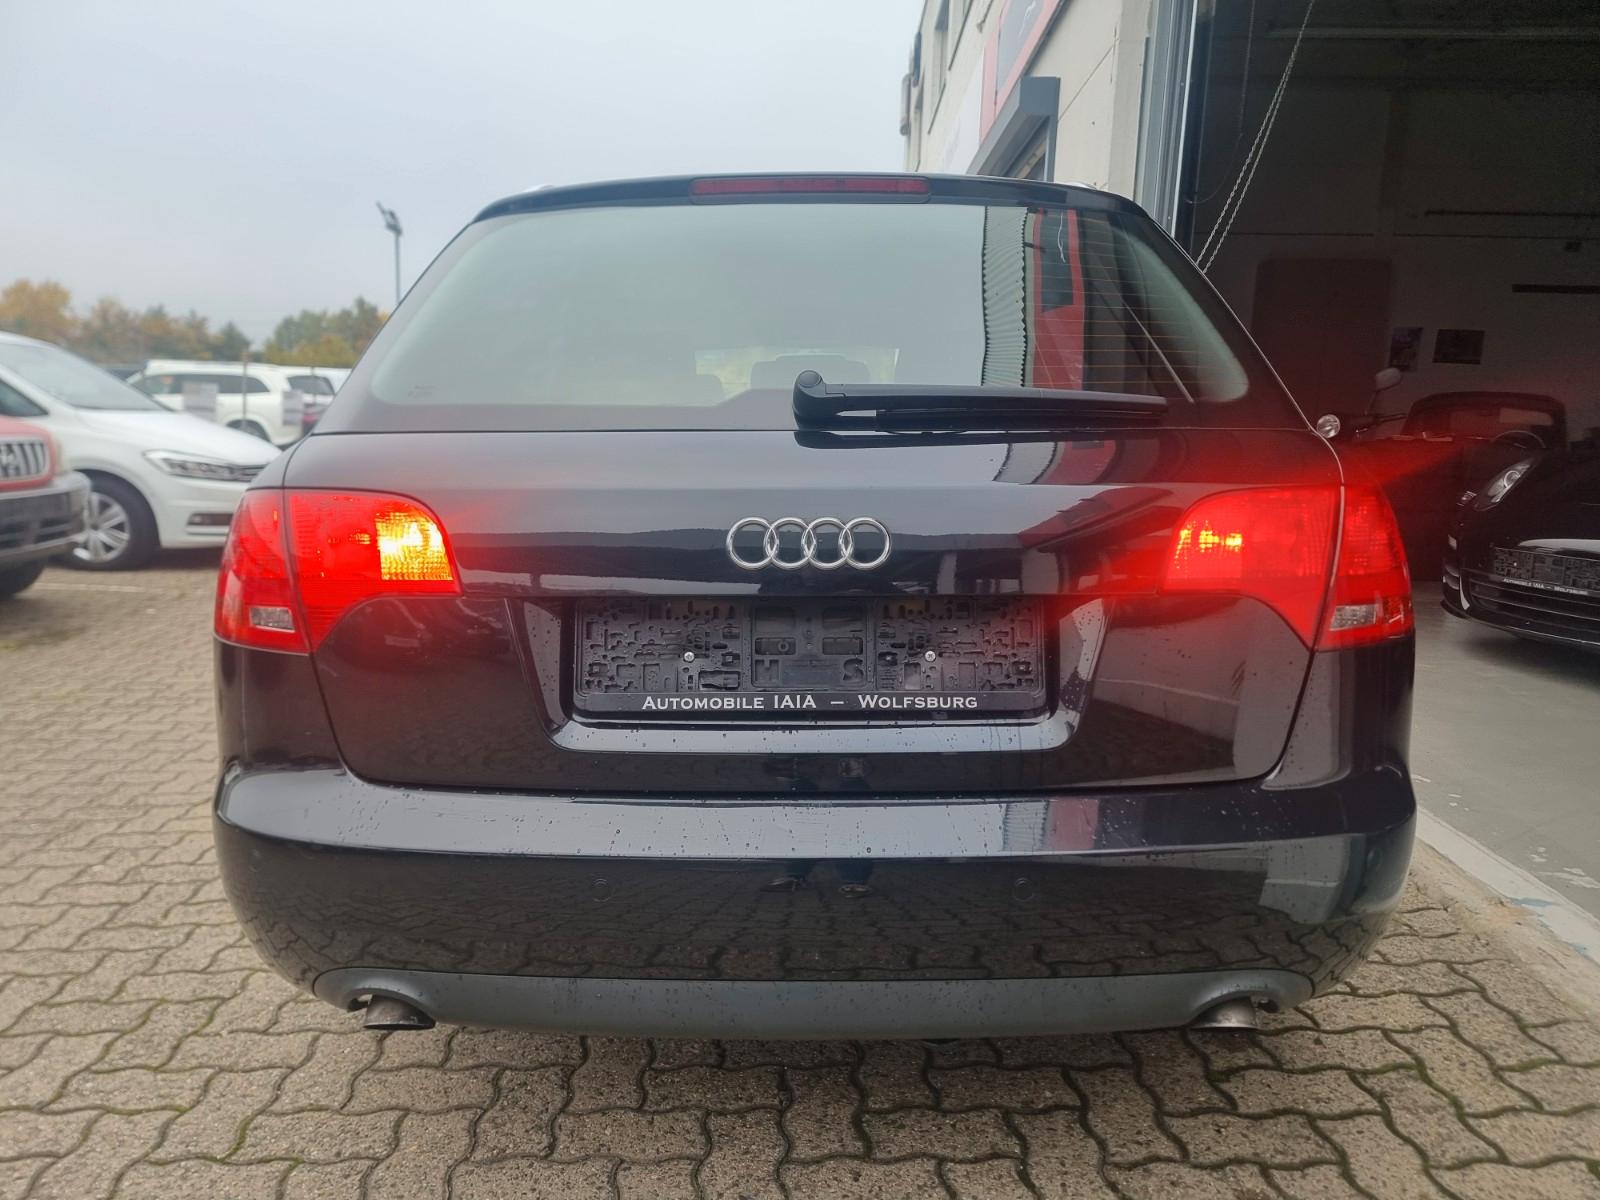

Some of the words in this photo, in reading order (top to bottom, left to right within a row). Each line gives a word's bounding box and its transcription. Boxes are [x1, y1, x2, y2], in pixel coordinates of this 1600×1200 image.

[642, 695, 765, 710] AUTOMOBILE
[773, 694, 817, 709] IAIA
[857, 694, 978, 709] WOLFSBURG
